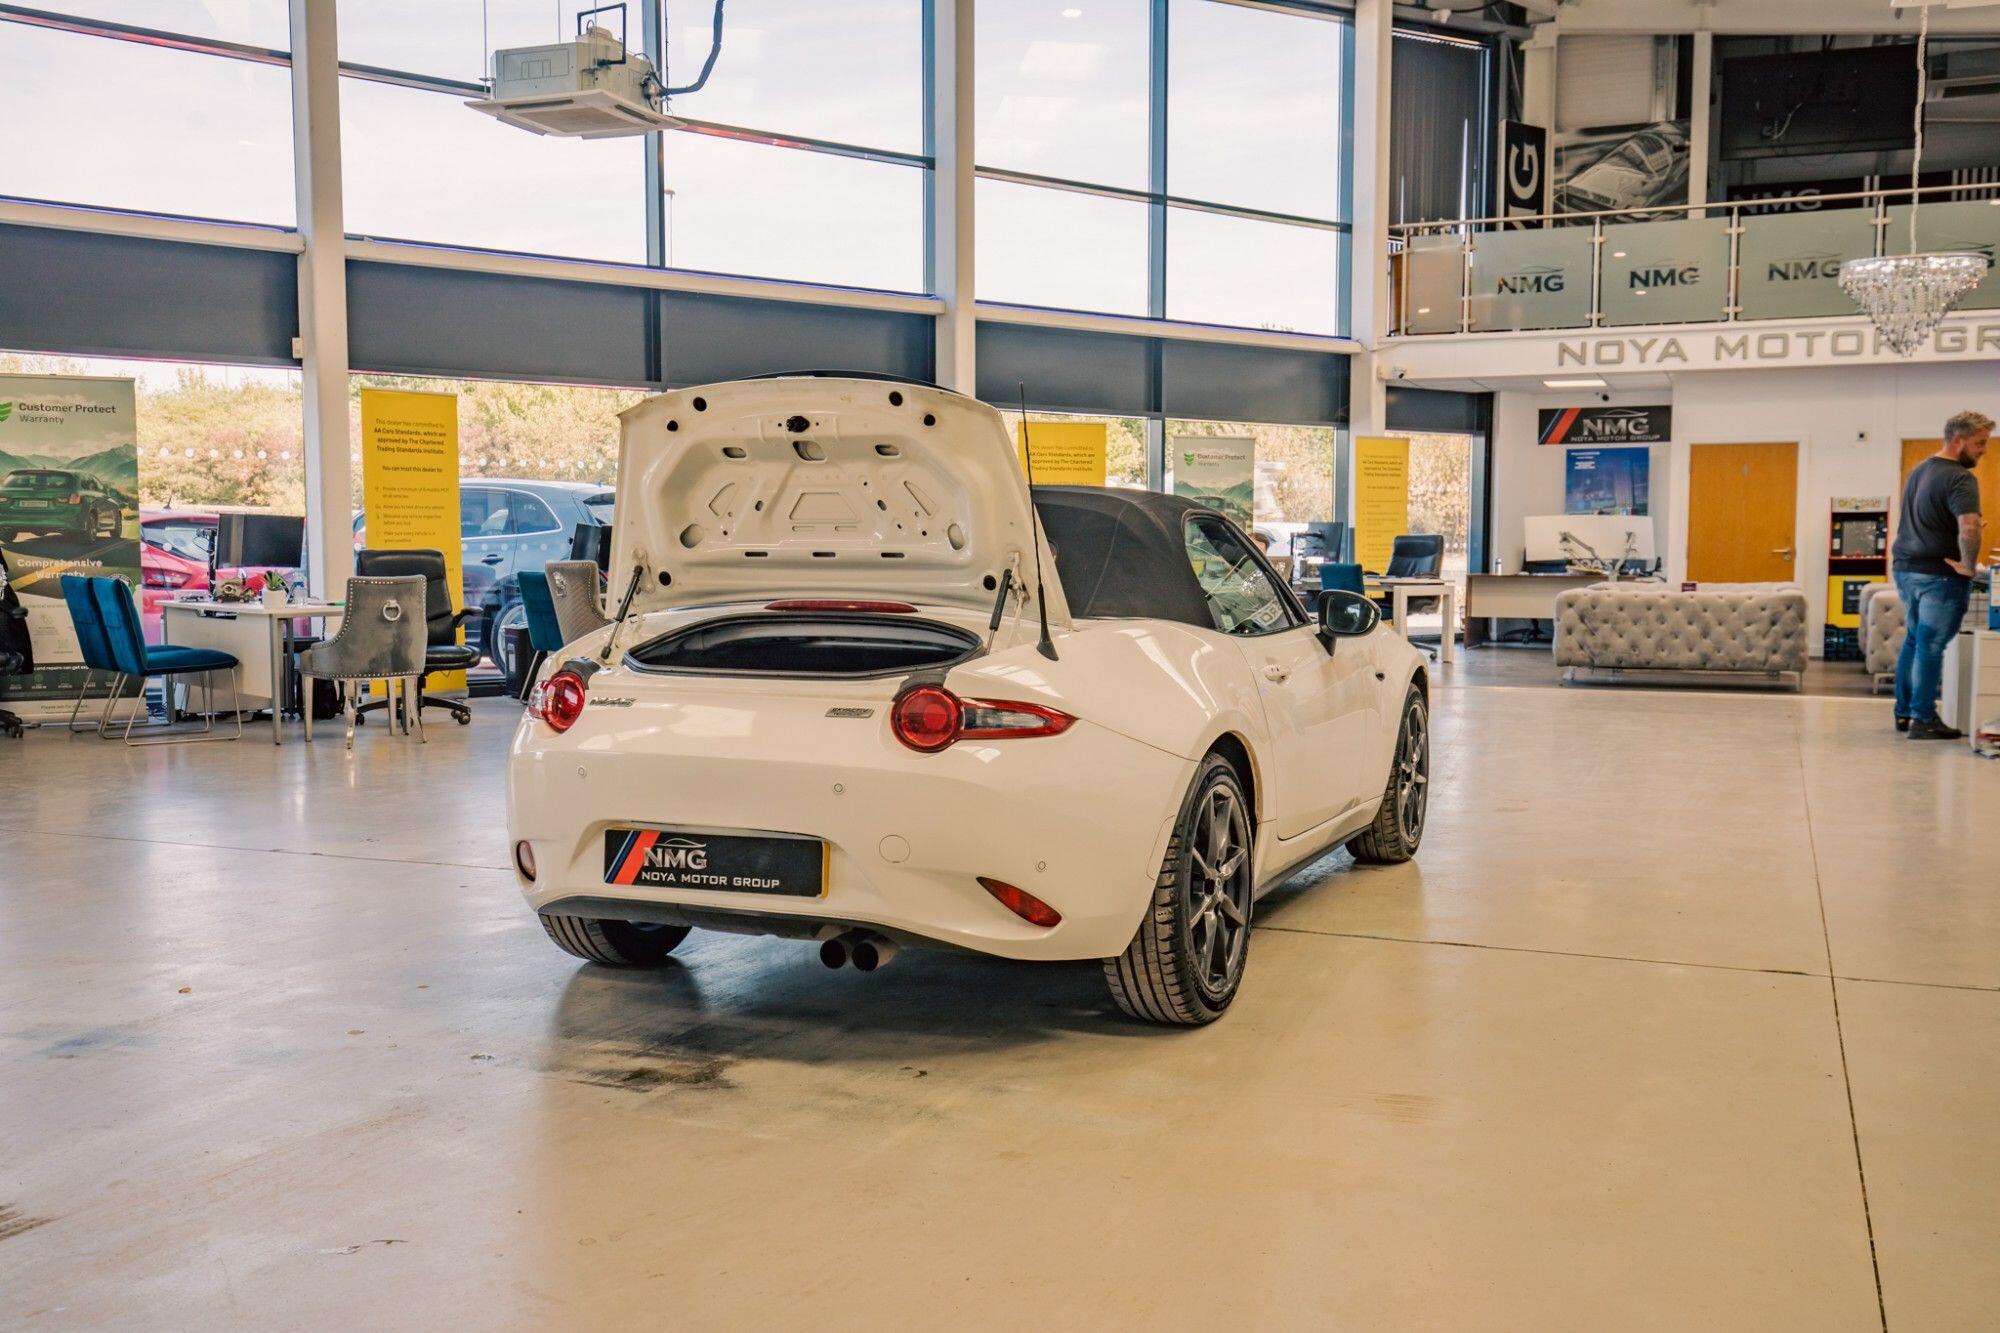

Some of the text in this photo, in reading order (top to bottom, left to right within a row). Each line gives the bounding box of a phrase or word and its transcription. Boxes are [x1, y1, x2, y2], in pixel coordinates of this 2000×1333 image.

[1733, 188, 1822, 215] NMG
[1629, 267, 1700, 289] NMG
[1768, 260, 1840, 281] NMG
[1498, 274, 1564, 294] NMG
[1558, 337, 1688, 367] NOYA
[19, 402, 116, 414] Customer Protect
[20, 415, 64, 424] Warranty
[1582, 417, 1649, 436] NMG
[17, 559, 103, 569] Comprehensive
[643, 847, 707, 870] NMG
[642, 871, 780, 889] NOYA MOTOR GROUP
